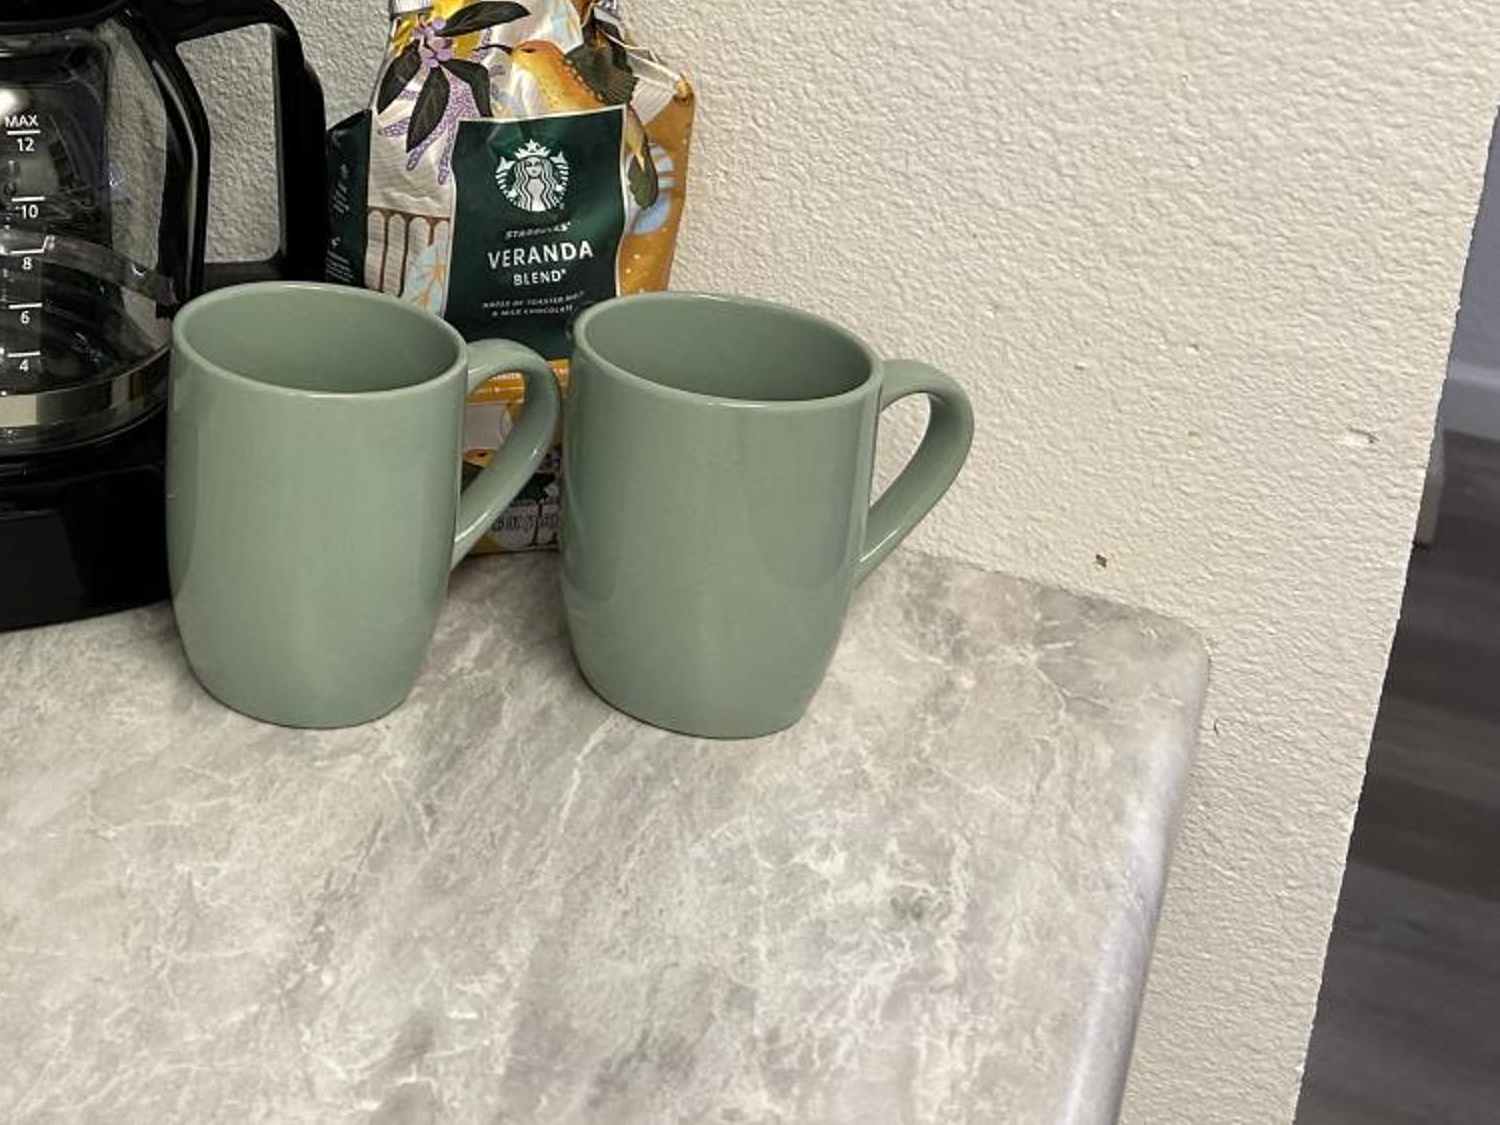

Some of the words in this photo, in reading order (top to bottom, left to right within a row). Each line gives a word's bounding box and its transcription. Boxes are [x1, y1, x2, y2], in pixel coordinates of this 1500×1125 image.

[5, 114, 39, 128] MAX
[17, 138, 35, 153] 12
[21, 203, 39, 219] 10
[487, 240, 594, 269] VERANDA
[22, 257, 33, 270] 8
[513, 270, 562, 286] BLEND
[20, 310, 30, 324] 6
[18, 358, 29, 372] 4
